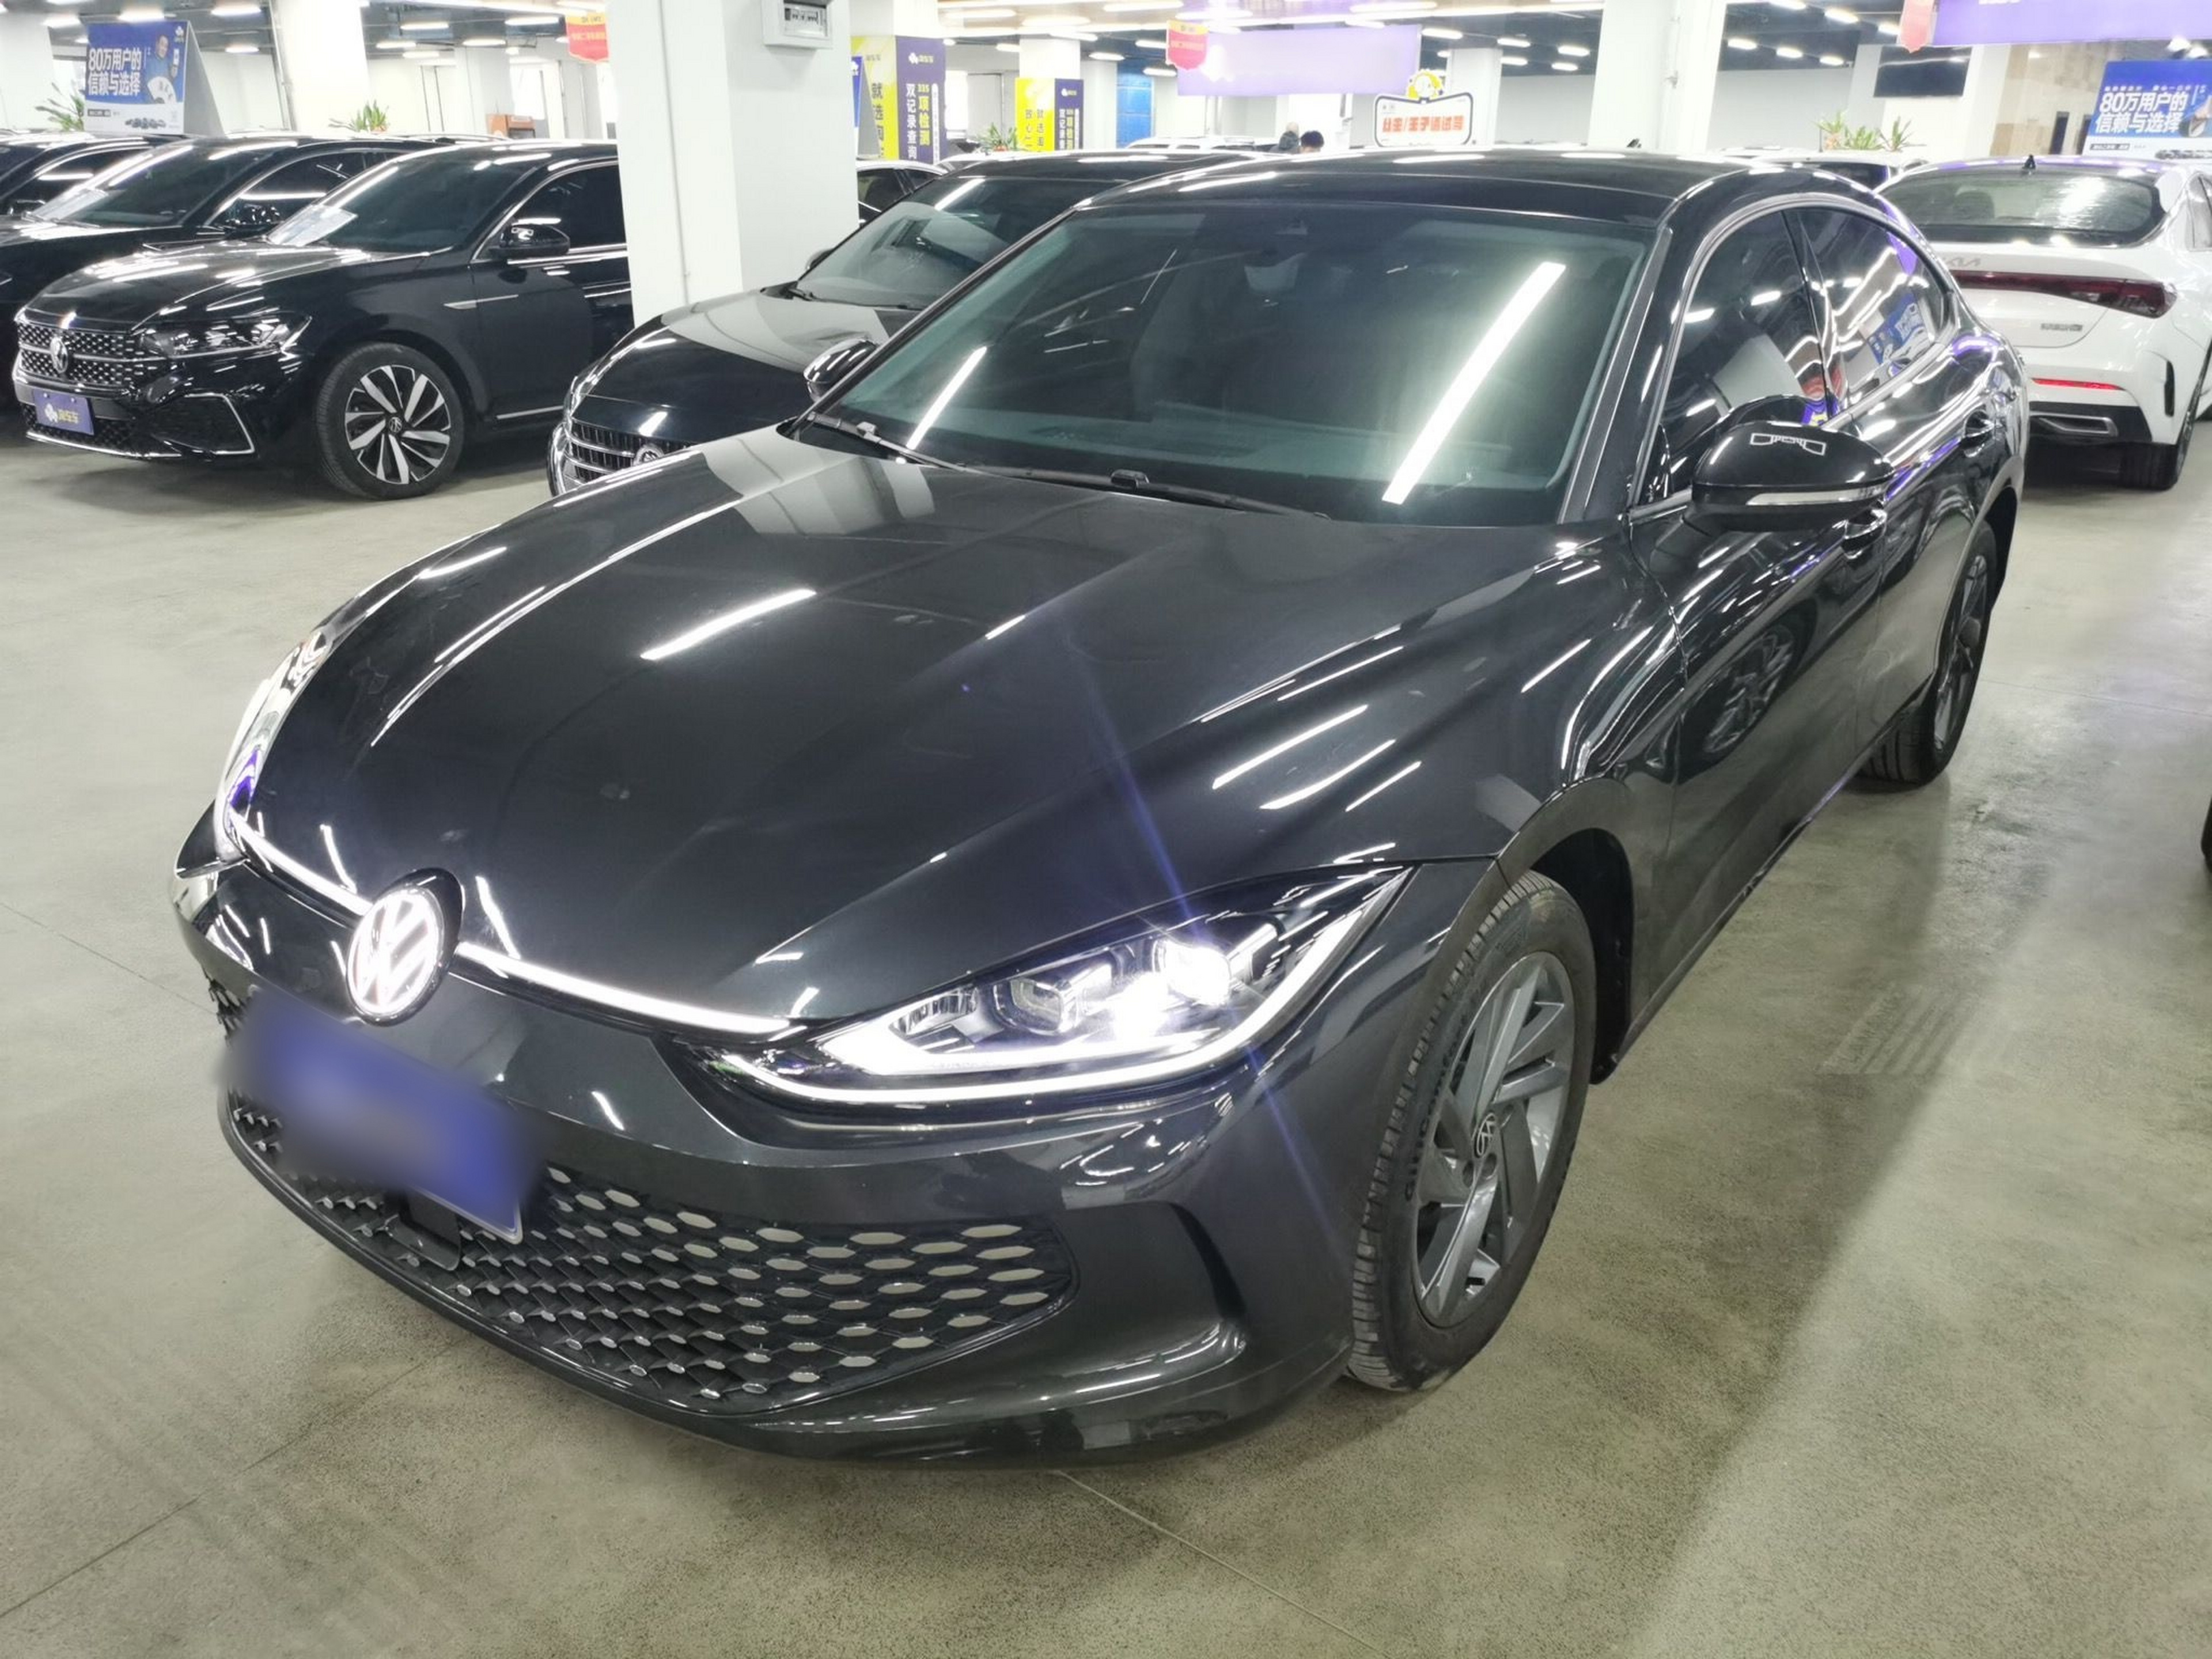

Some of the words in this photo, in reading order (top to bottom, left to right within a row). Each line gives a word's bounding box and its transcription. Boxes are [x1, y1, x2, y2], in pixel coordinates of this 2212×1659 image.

[89, 47, 142, 71] 80万用户的
[88, 71, 141, 96] 信赖与选择
[2099, 91, 2189, 112] 80万用户的
[2095, 112, 2184, 133] 信赖与选择
